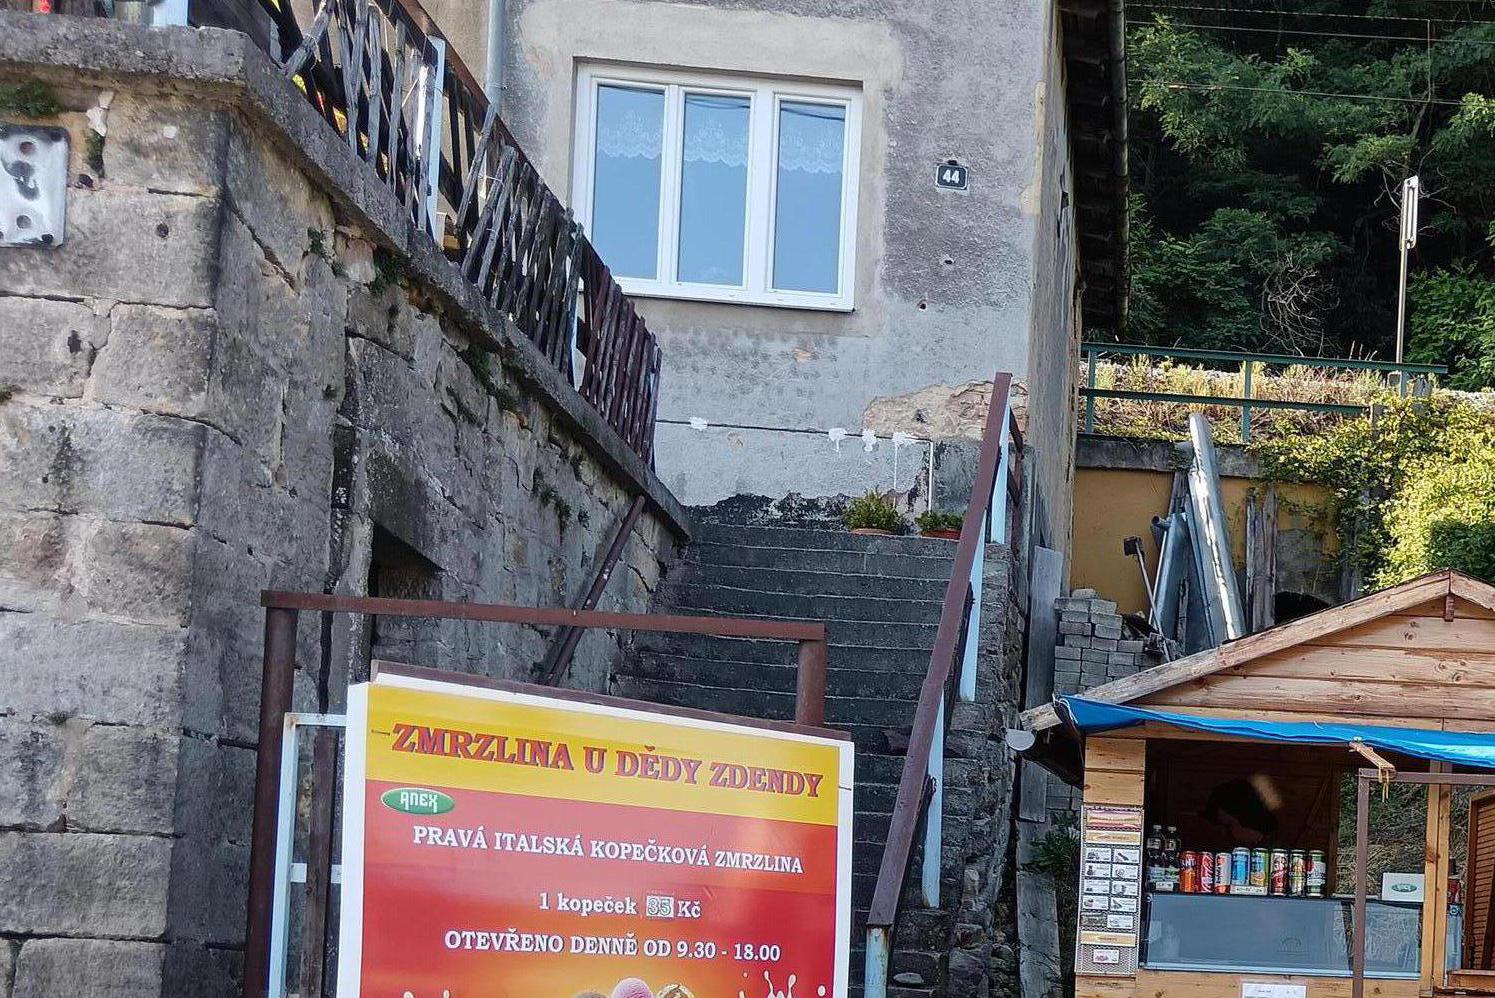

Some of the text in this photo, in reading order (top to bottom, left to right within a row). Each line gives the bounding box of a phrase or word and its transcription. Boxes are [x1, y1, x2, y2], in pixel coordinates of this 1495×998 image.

[942, 168, 960, 184] 44
[391, 722, 824, 798] ZMRZLINA U DĚDY ZDENDY
[412, 825, 804, 874] PRAVÁ ITALSKÁ KOPEČKOVÁ ZMRZLINA
[538, 892, 702, 918] 1 kopeček 35 Kč
[443, 927, 565, 955] OTEVŘENO
[569, 931, 639, 957] DENNĚ
[642, 939, 672, 958] OD
[675, 941, 717, 960] 9.30
[732, 943, 782, 963] 18.00
